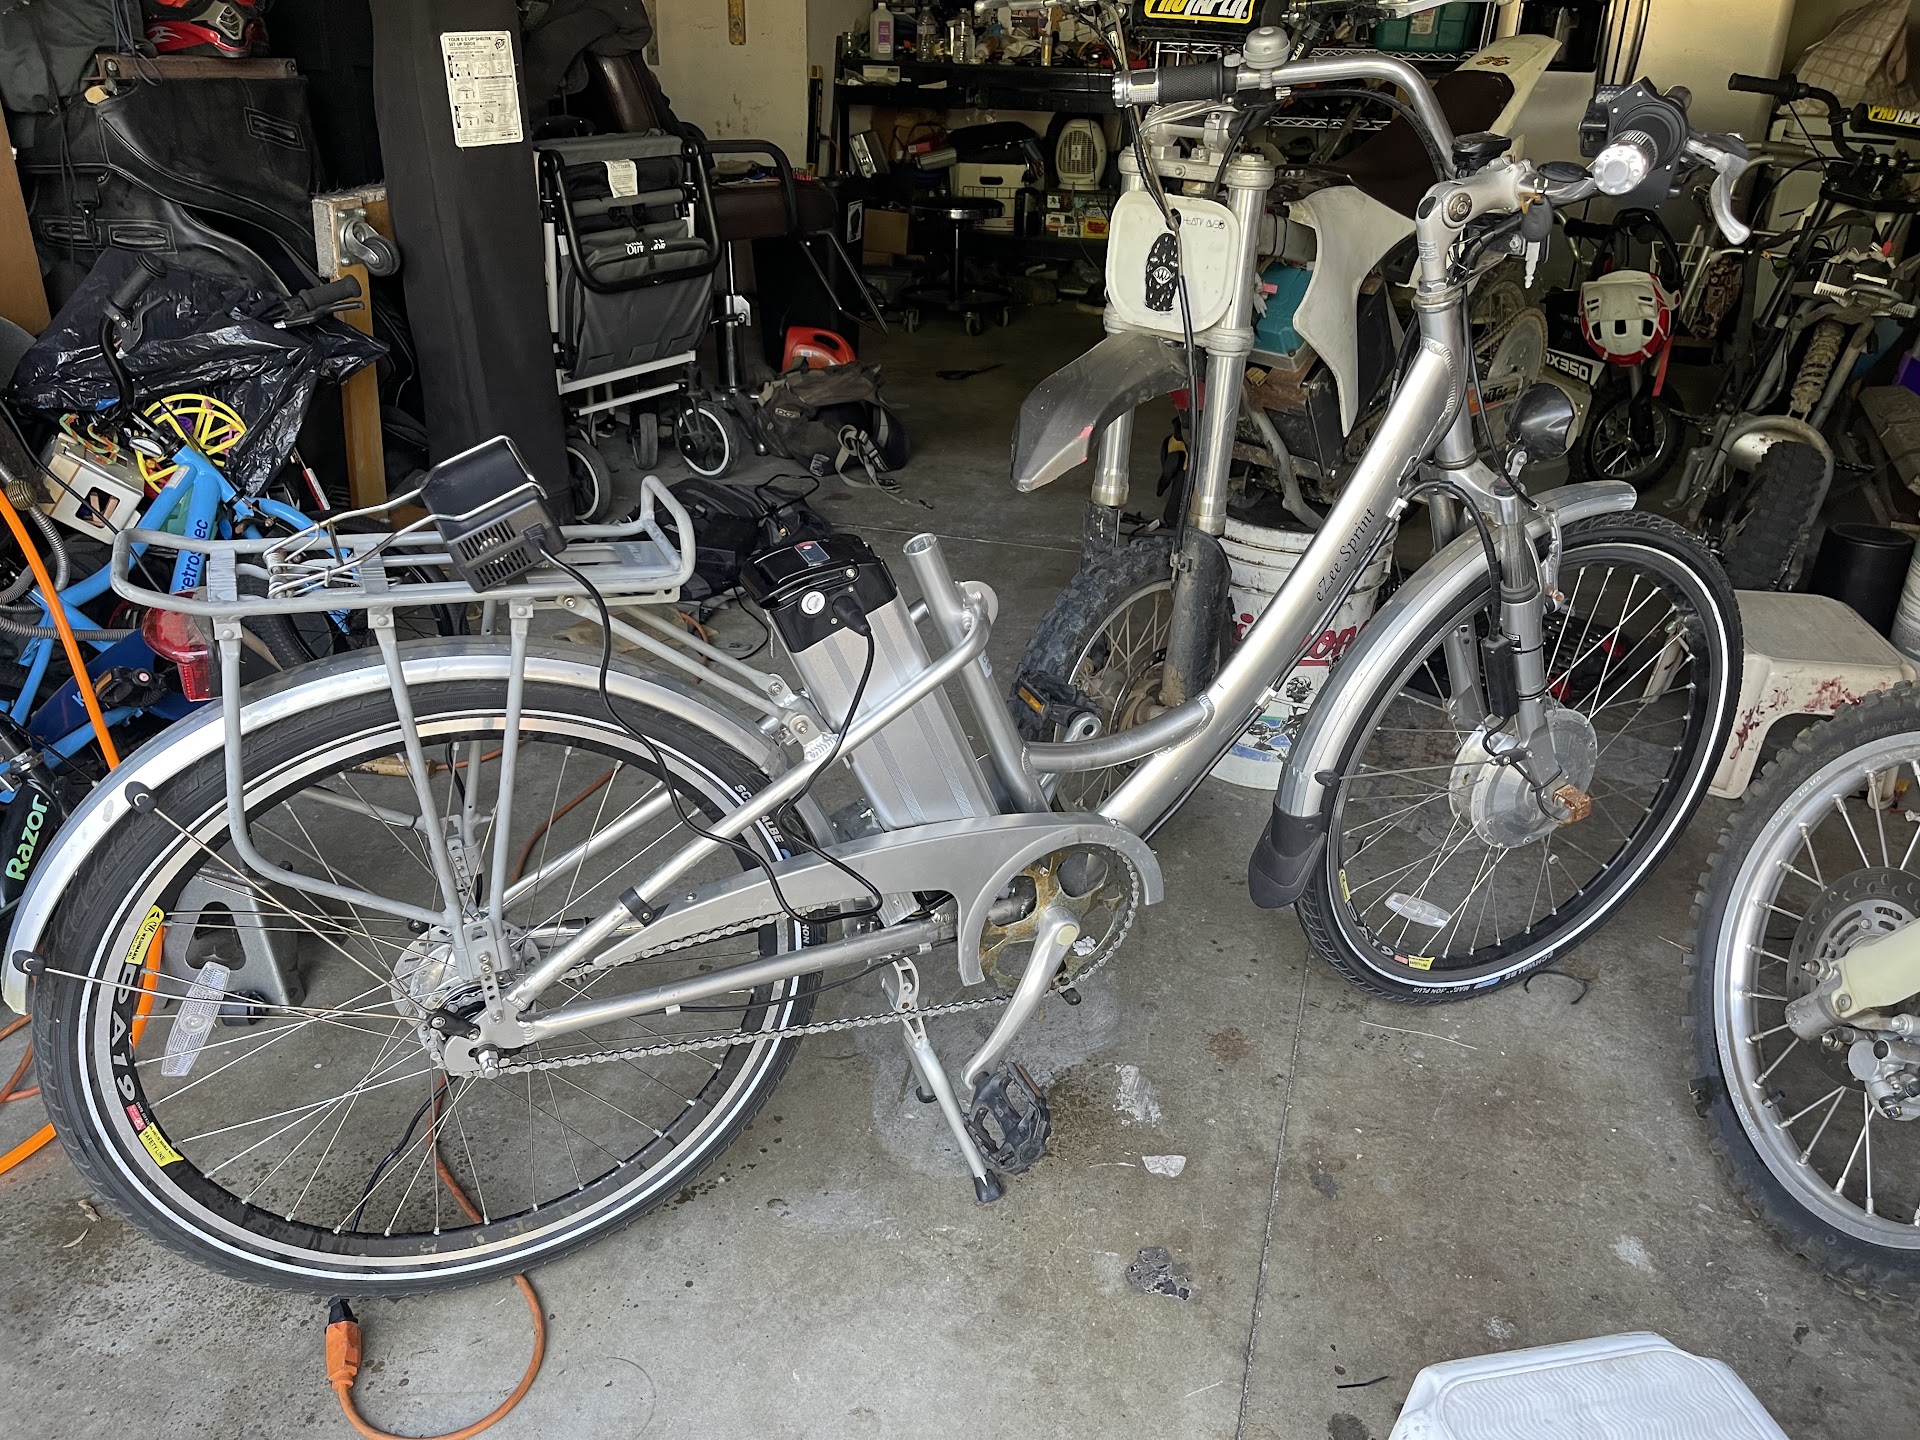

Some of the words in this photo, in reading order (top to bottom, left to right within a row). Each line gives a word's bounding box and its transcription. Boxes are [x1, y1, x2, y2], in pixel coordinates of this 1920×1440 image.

[1316, 562, 1342, 602] eZee
[1339, 507, 1376, 562] Sprint
[734, 783, 785, 844] SCALBE
[1504, 950, 1554, 980] SCHWALBE
[1412, 986, 1431, 994] PLUS
[142, 1131, 157, 1150] SAFETY
[155, 1149, 165, 1161] LINE
